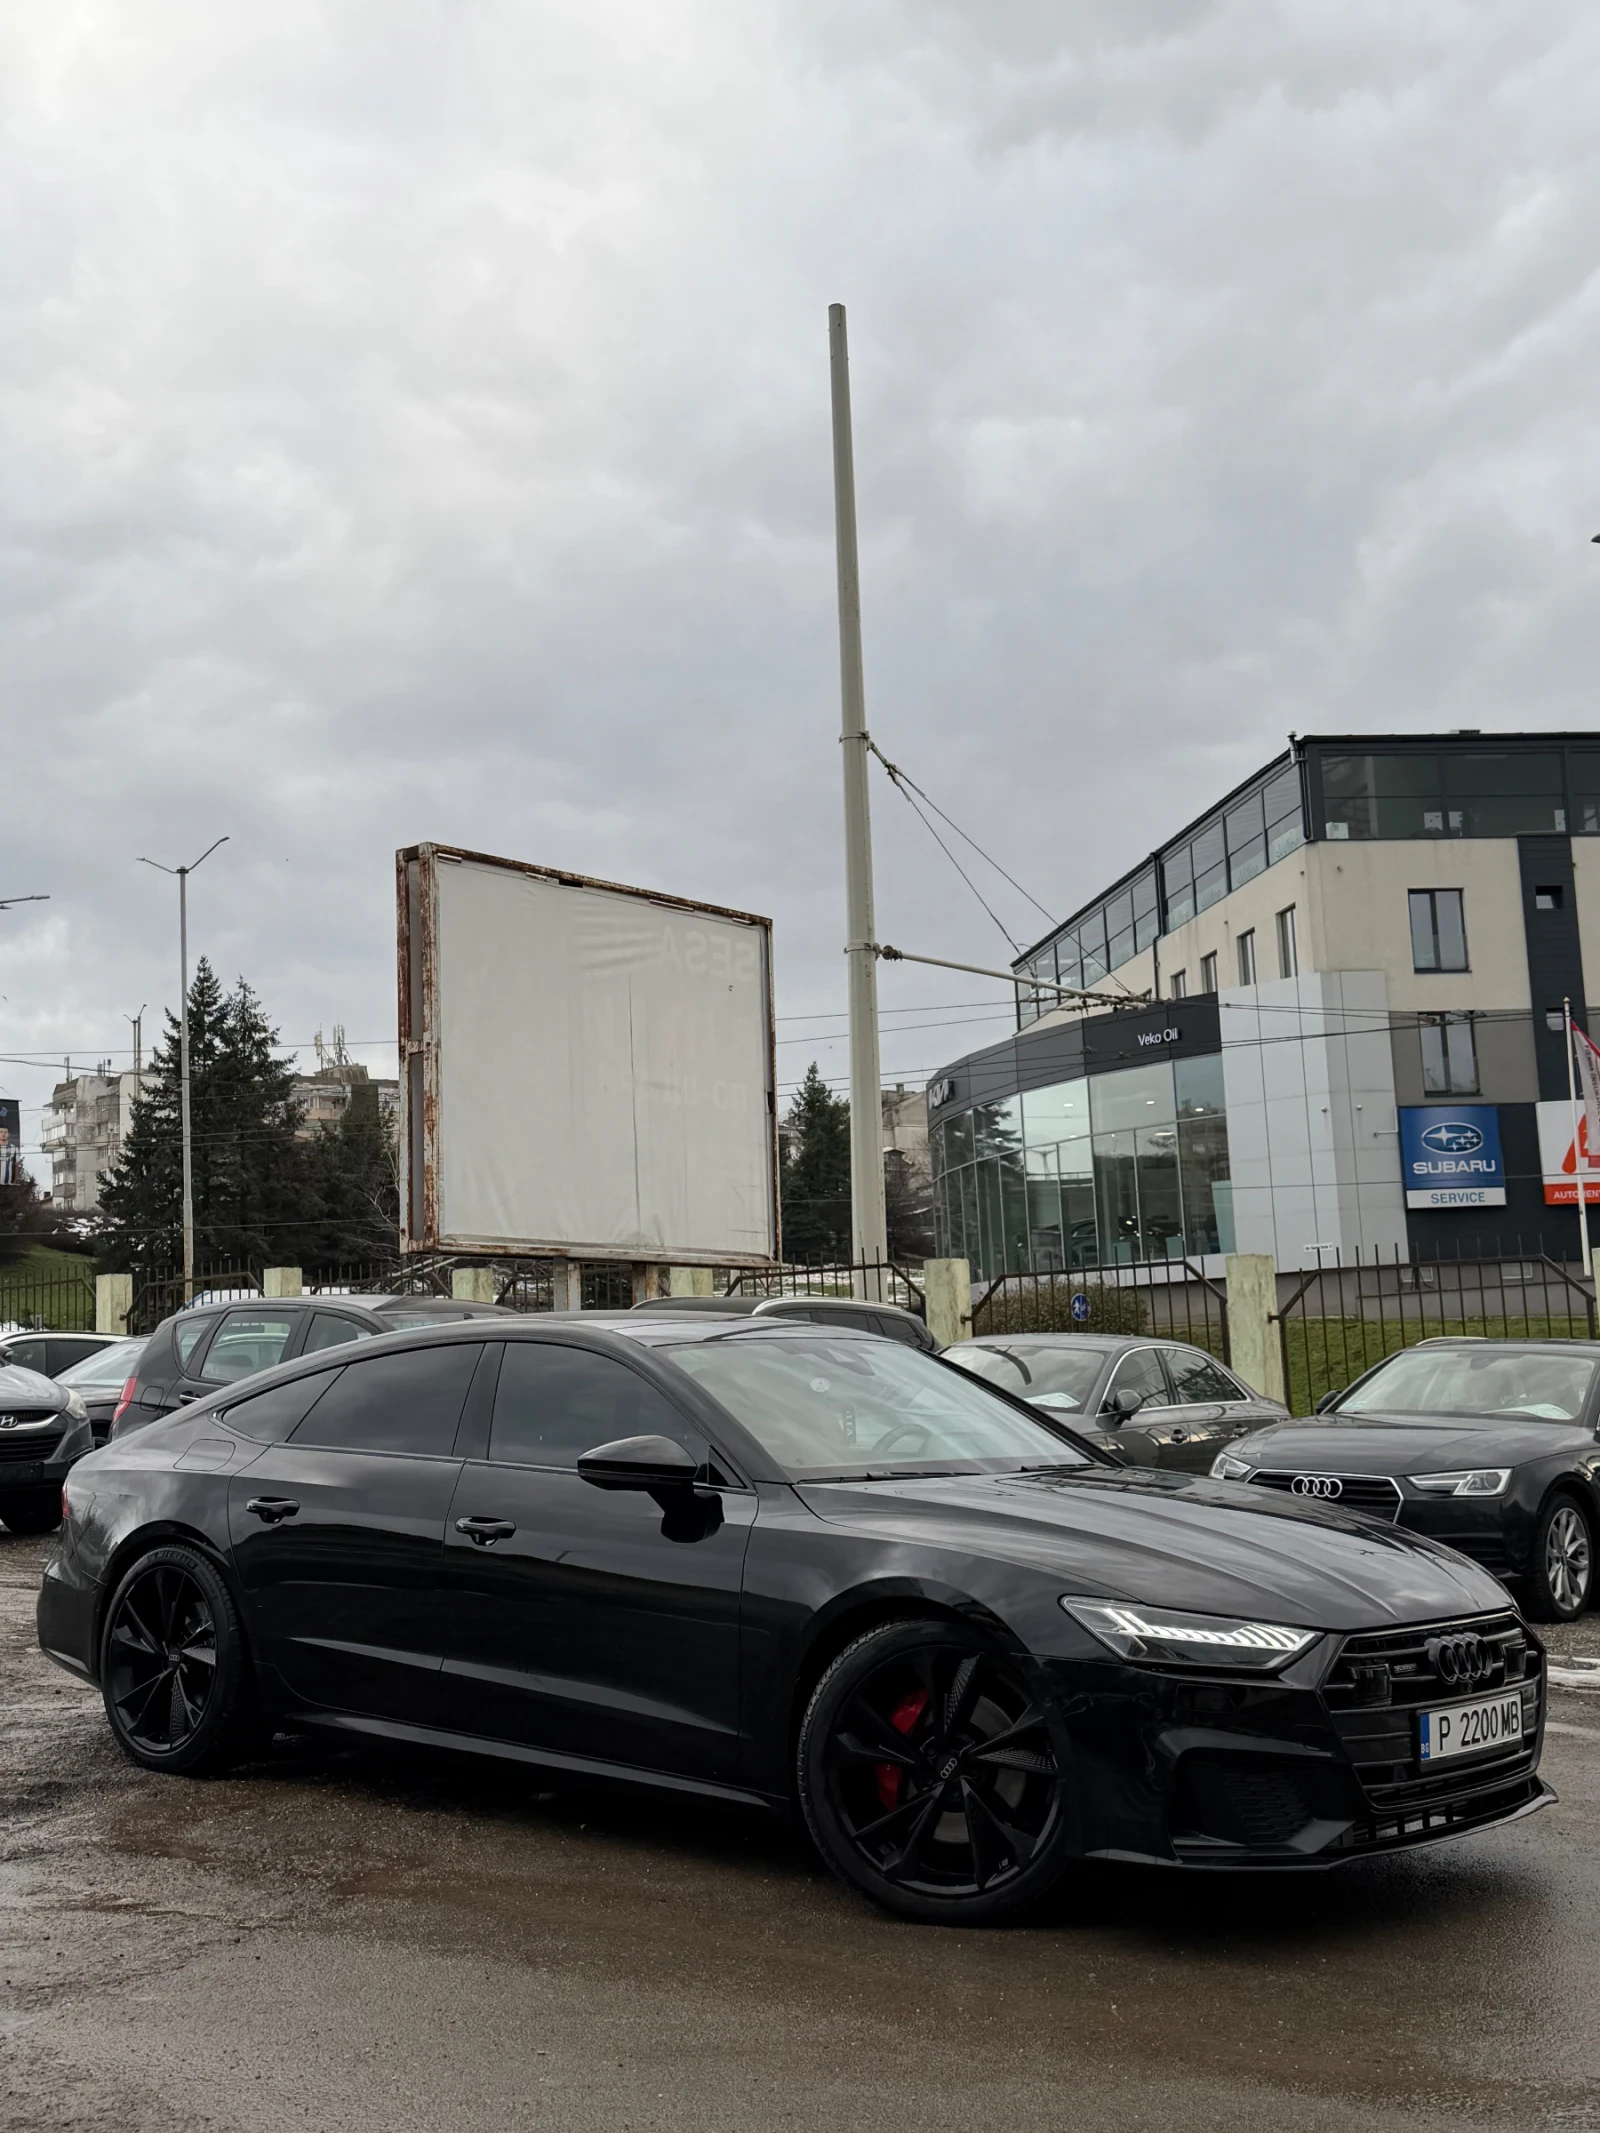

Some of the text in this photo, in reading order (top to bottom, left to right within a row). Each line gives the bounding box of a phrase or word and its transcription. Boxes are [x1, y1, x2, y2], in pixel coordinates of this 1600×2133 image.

[1137, 1027, 1178, 1046] Veko Oil
[1412, 1159, 1496, 1175] SUBARU
[1430, 1192, 1486, 1204] SERVICE
[1439, 1700, 1520, 1751] P 2200 MB
[1420, 1743, 1430, 1754] BG
